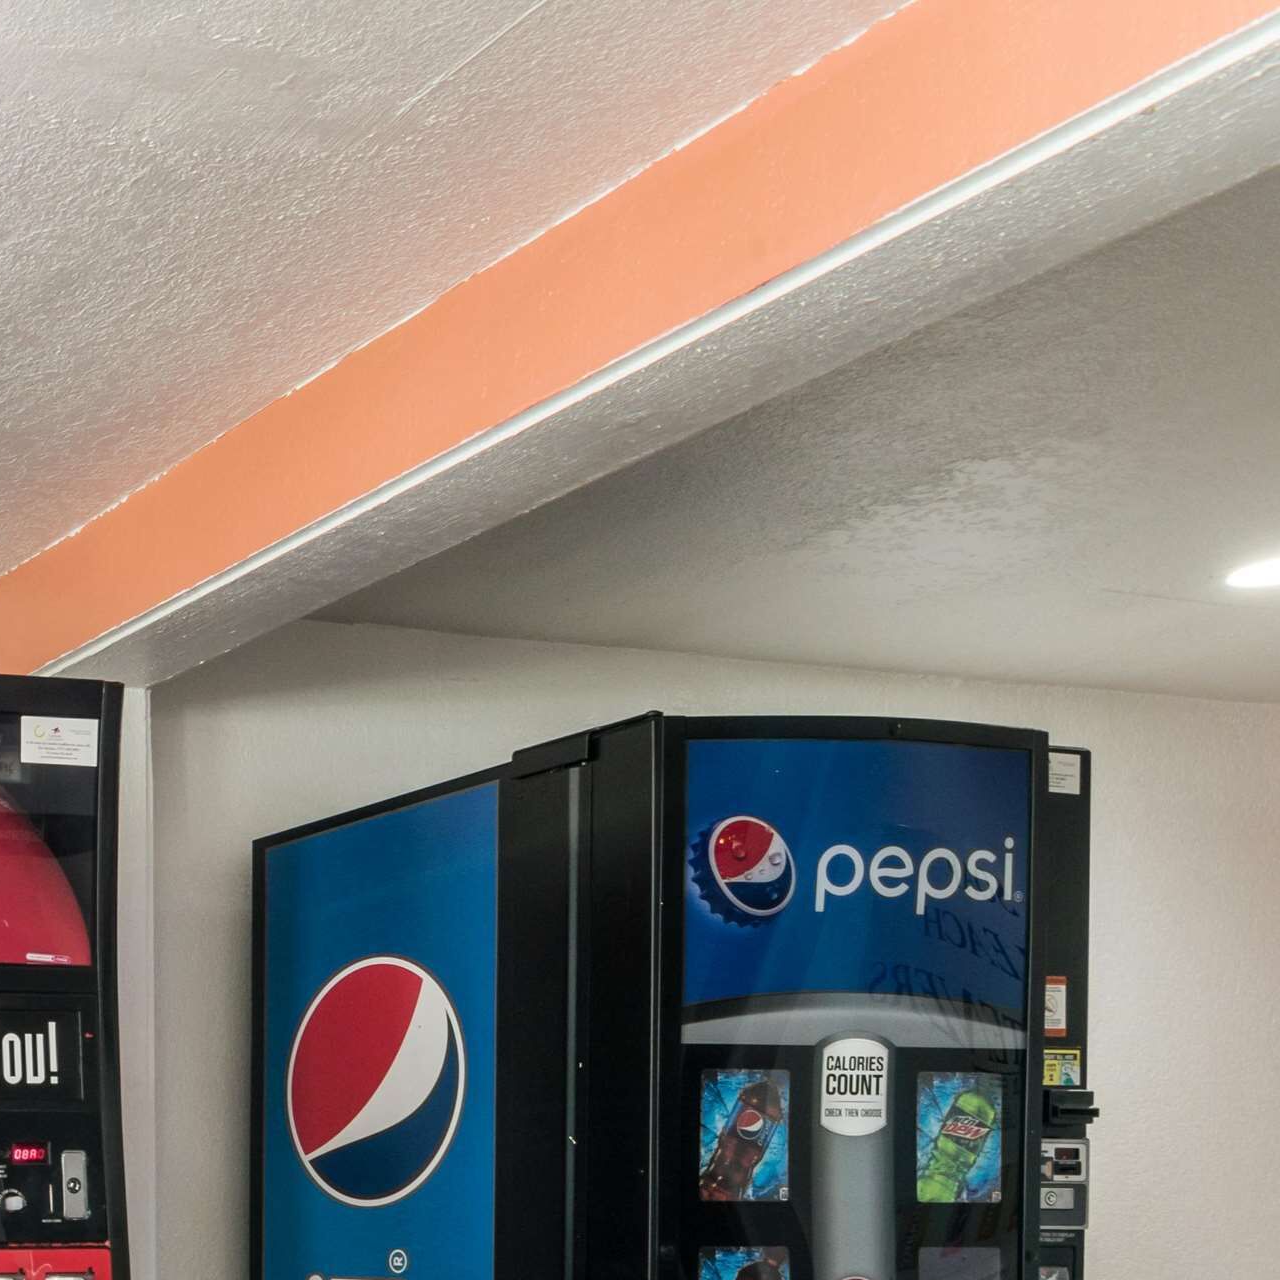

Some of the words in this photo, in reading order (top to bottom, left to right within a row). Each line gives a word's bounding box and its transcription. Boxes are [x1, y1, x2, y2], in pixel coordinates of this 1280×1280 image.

[815, 837, 1015, 915] pepsi
[826, 1056, 884, 1071] CALORIES
[825, 1073, 883, 1096] COUNT
